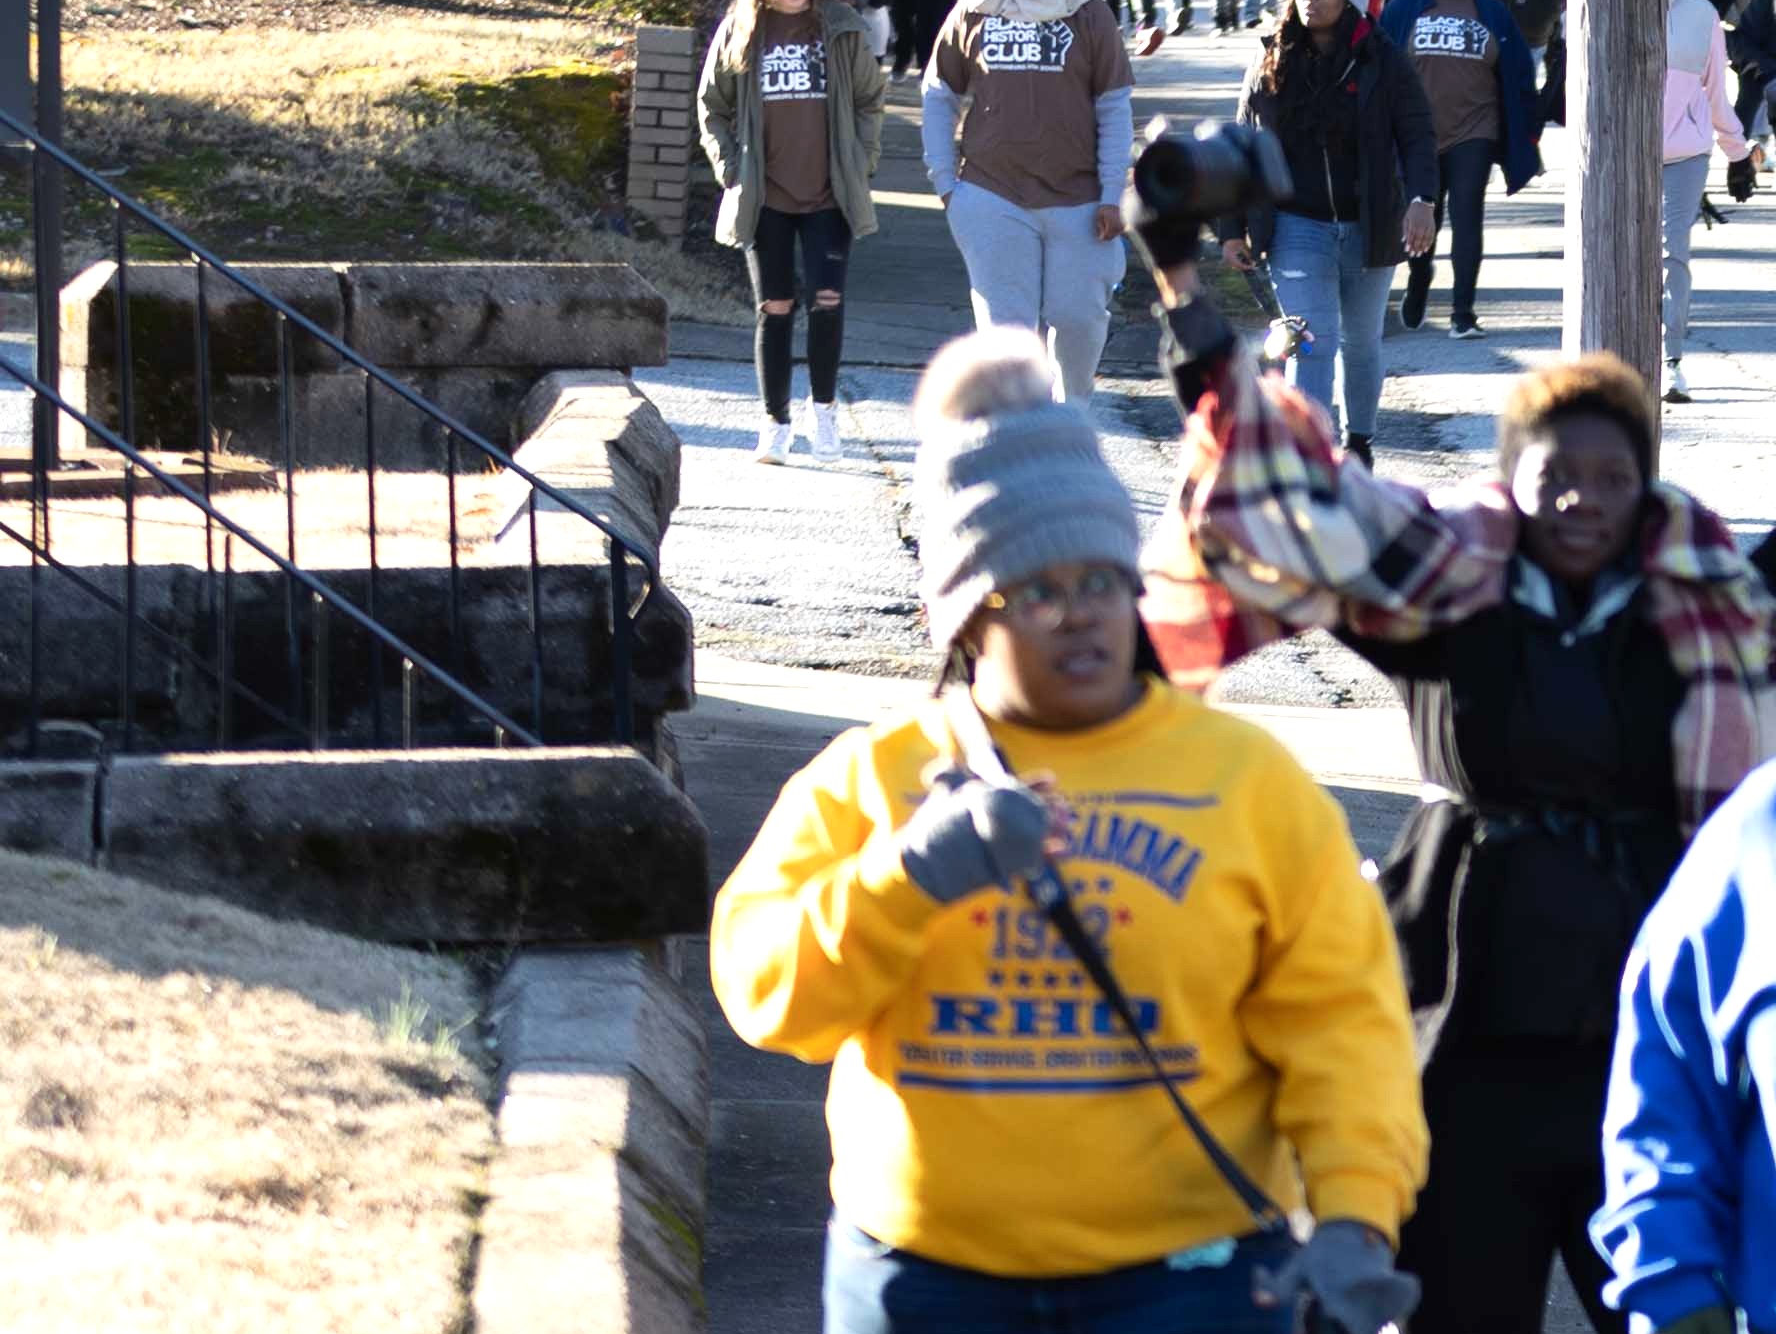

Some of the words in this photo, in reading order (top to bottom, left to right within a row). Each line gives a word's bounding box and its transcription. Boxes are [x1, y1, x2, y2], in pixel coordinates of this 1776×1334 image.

[1416, 16, 1466, 27] BLACK
[984, 30, 1041, 43] HISTORY
[1414, 34, 1465, 50] CLUB
[763, 44, 810, 59] LACK
[983, 43, 1042, 62] CLUB
[762, 58, 809, 72] STORY
[761, 72, 812, 93] LUB
[928, 993, 1162, 1038] RHO
